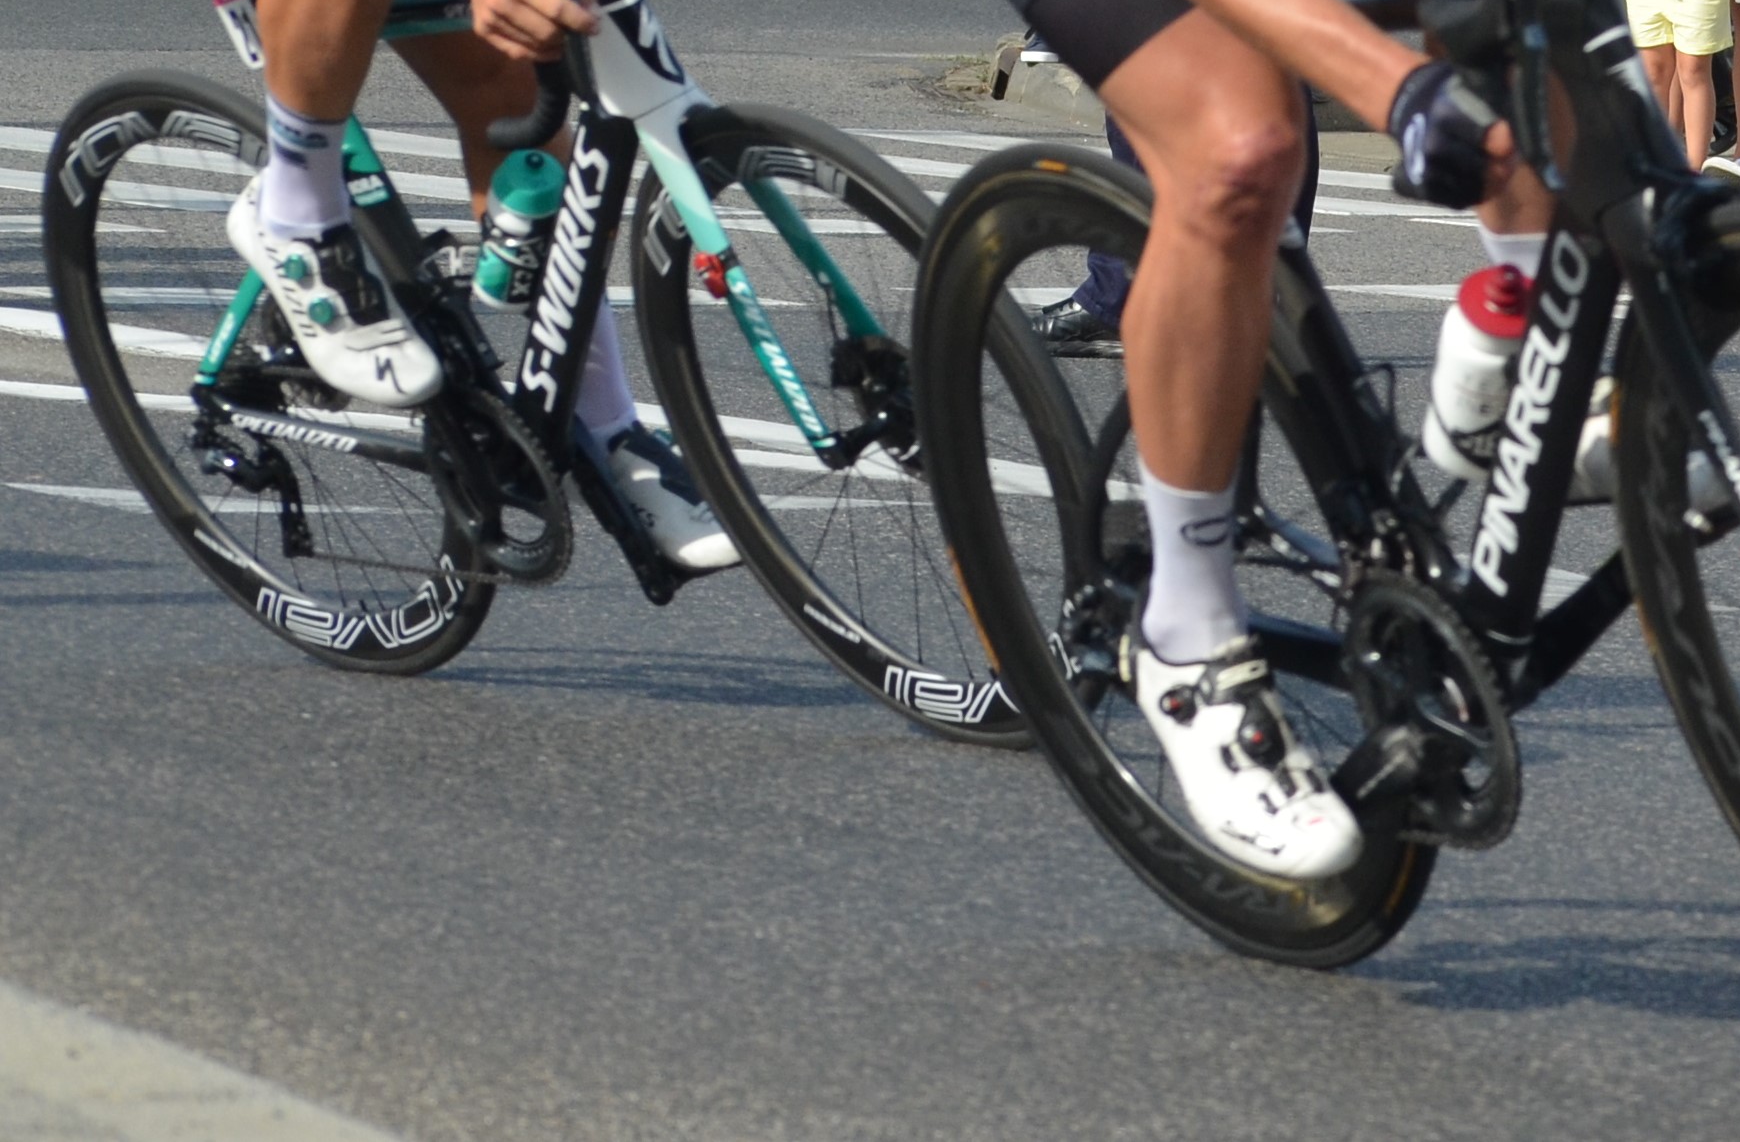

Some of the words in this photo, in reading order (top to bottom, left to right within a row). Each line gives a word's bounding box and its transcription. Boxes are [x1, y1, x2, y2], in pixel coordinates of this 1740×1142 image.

[520, 124, 611, 413] S-WORKS
[230, 412, 359, 453] SPECIALIZED
[1472, 229, 1589, 598] PINARELLO
